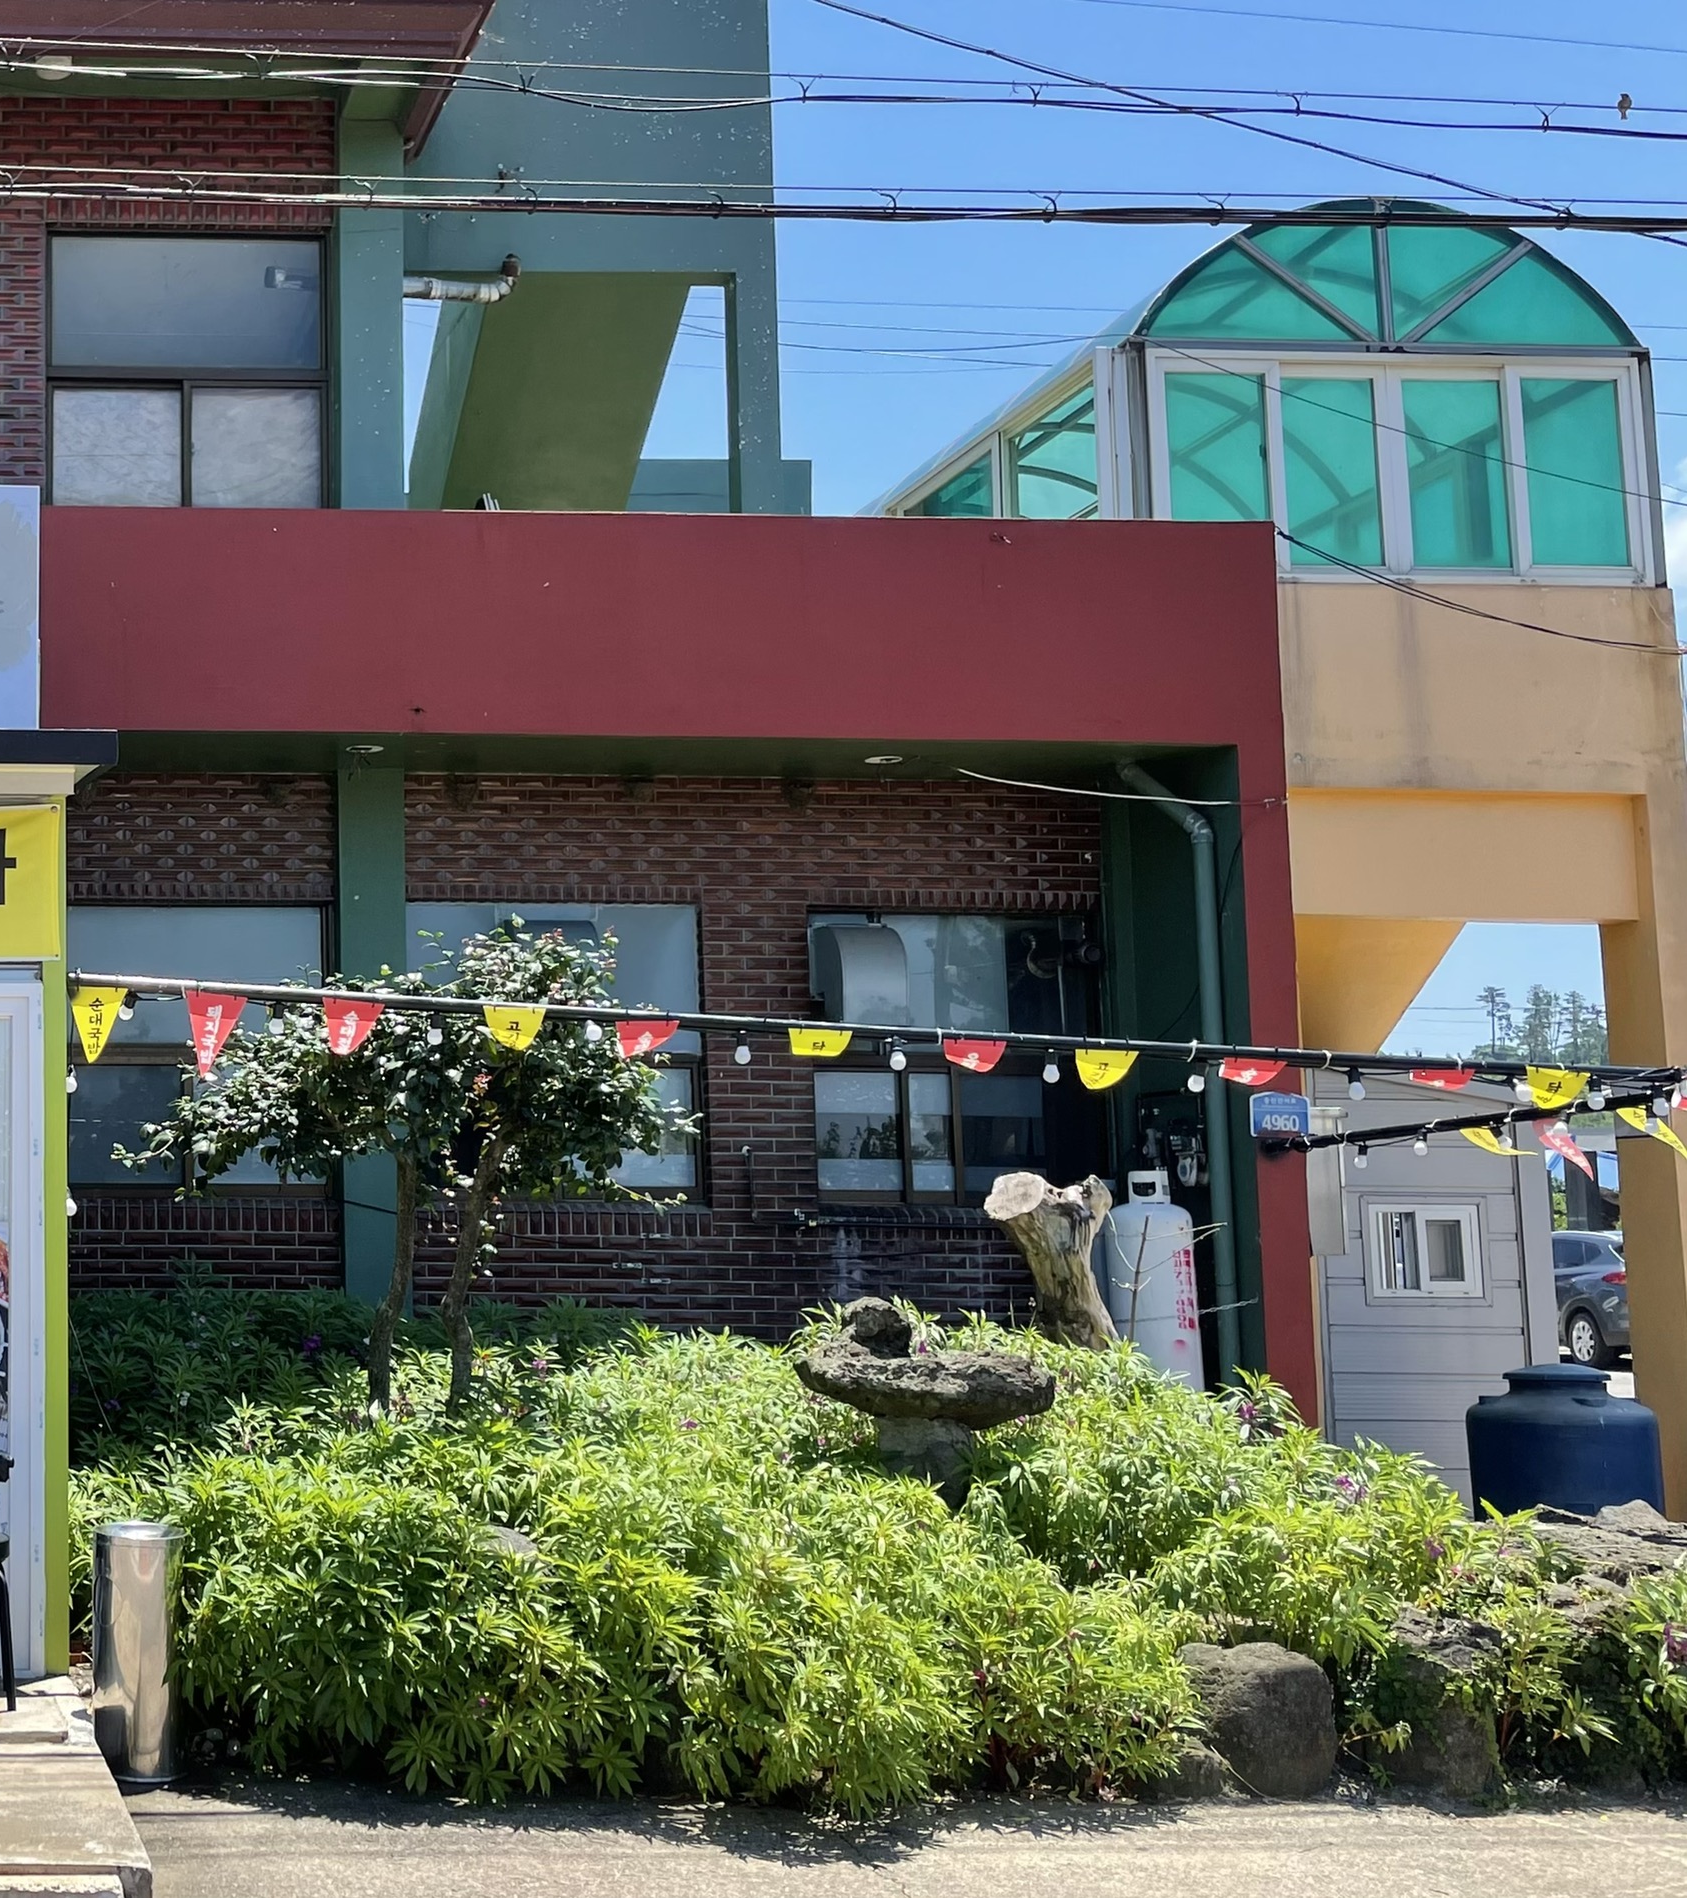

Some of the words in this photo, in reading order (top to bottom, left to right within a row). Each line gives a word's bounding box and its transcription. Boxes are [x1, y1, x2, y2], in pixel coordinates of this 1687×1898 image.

[87, 997, 105, 1055] 순대국밥
[199, 1004, 223, 1066] 돼지국밥
[1261, 1114, 1300, 1132] 4960
